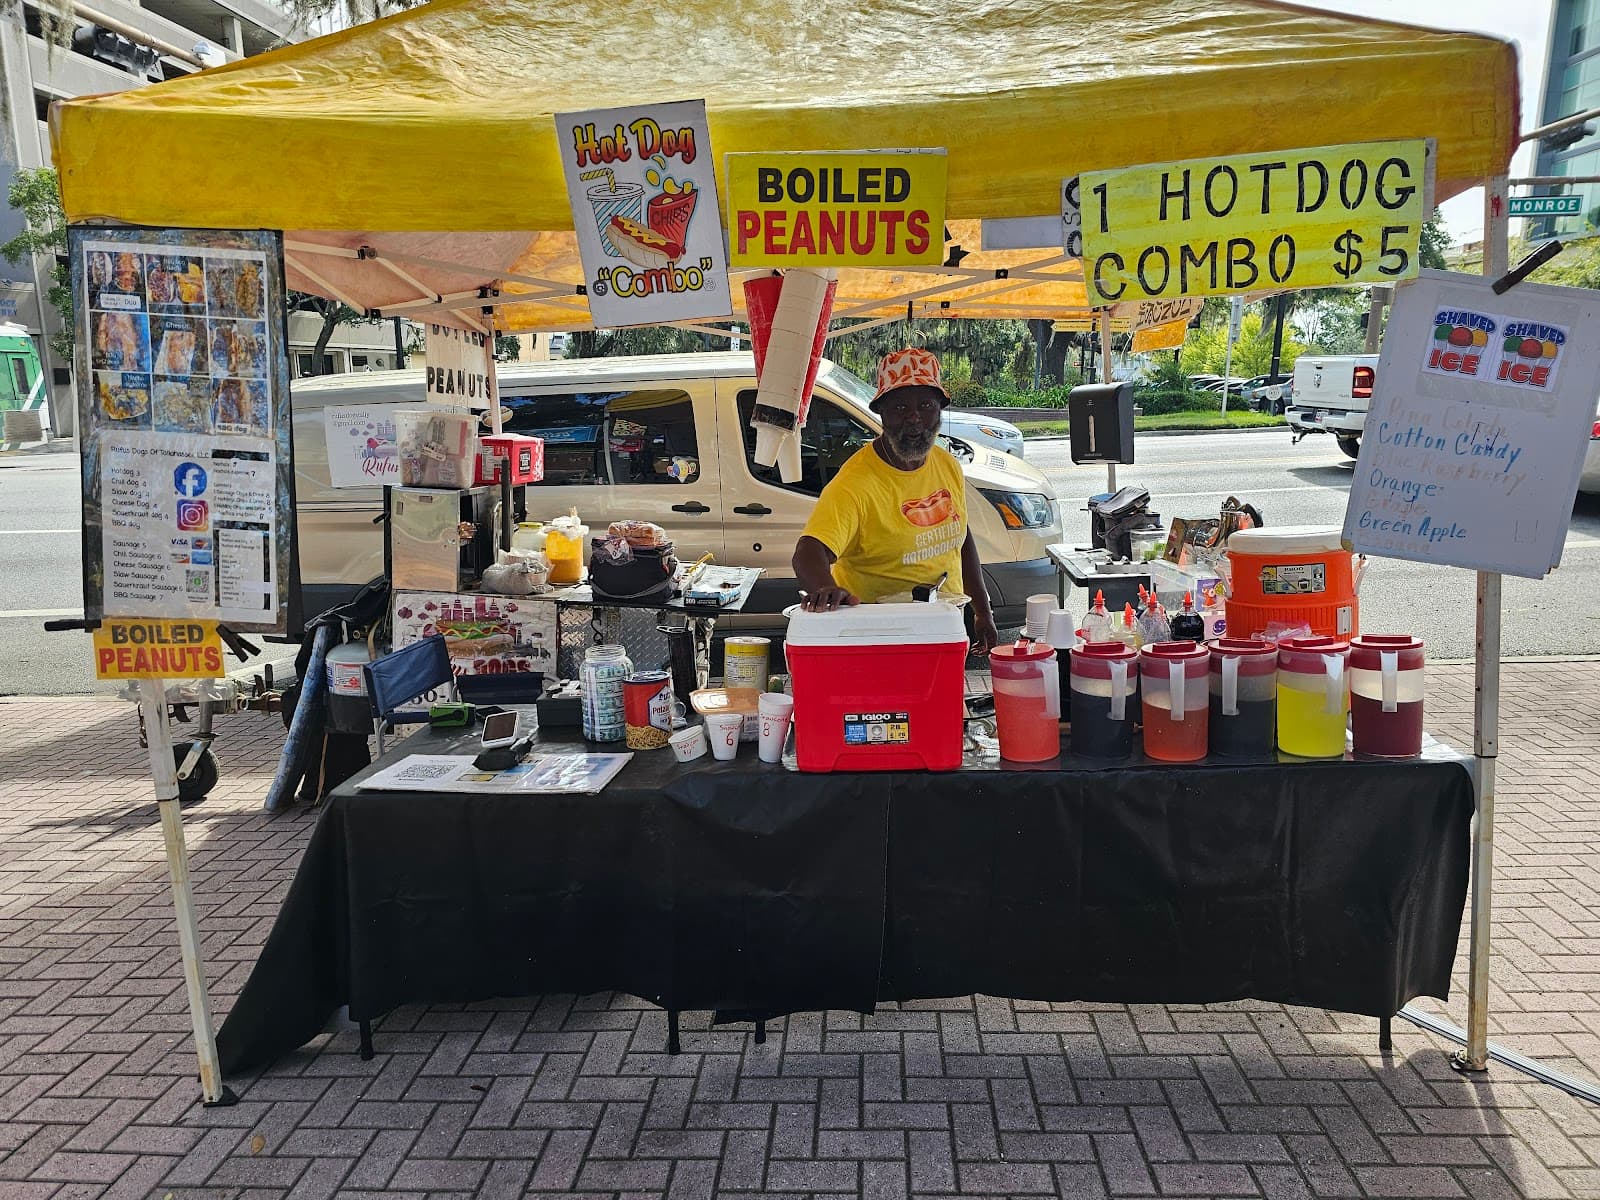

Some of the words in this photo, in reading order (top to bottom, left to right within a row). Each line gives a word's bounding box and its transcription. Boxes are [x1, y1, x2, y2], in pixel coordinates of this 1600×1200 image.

[573, 122, 632, 167] Hot
[629, 117, 696, 164] Dog
[758, 167, 911, 203] BOILED
[1093, 183, 1109, 233] 1
[1158, 157, 1416, 222] HOTDOG
[652, 203, 691, 226] CHIPS
[1511, 200, 1577, 212] MONROE
[737, 209, 931, 255] PEANUTS
[1094, 233, 1297, 300] COMBO
[1333, 225, 1410, 280] $5
[1435, 311, 1496, 334] SHAVED
[1503, 323, 1566, 346] SHAVED
[1428, 348, 1480, 375] ICE
[1497, 360, 1550, 387] ICE
[1379, 421, 1447, 450] Cotton
[1455, 432, 1522, 473] Candy
[915, 521, 961, 547] CERTIFIED
[1359, 511, 1412, 535] Green
[1418, 516, 1467, 542] Apple
[113, 540, 140, 550] Sausage
[129, 552, 155, 561] Sausage
[131, 573, 158, 582] Sausage
[138, 561, 164, 572] Sausage
[130, 593, 156, 602] Sausage
[152, 584, 178, 593] Sausage
[112, 624, 204, 644] BOILED
[99, 647, 221, 673] PEANUTS
[861, 713, 891, 721] IGLOO
[726, 731, 734, 746] 6
[763, 722, 770, 736] 8
